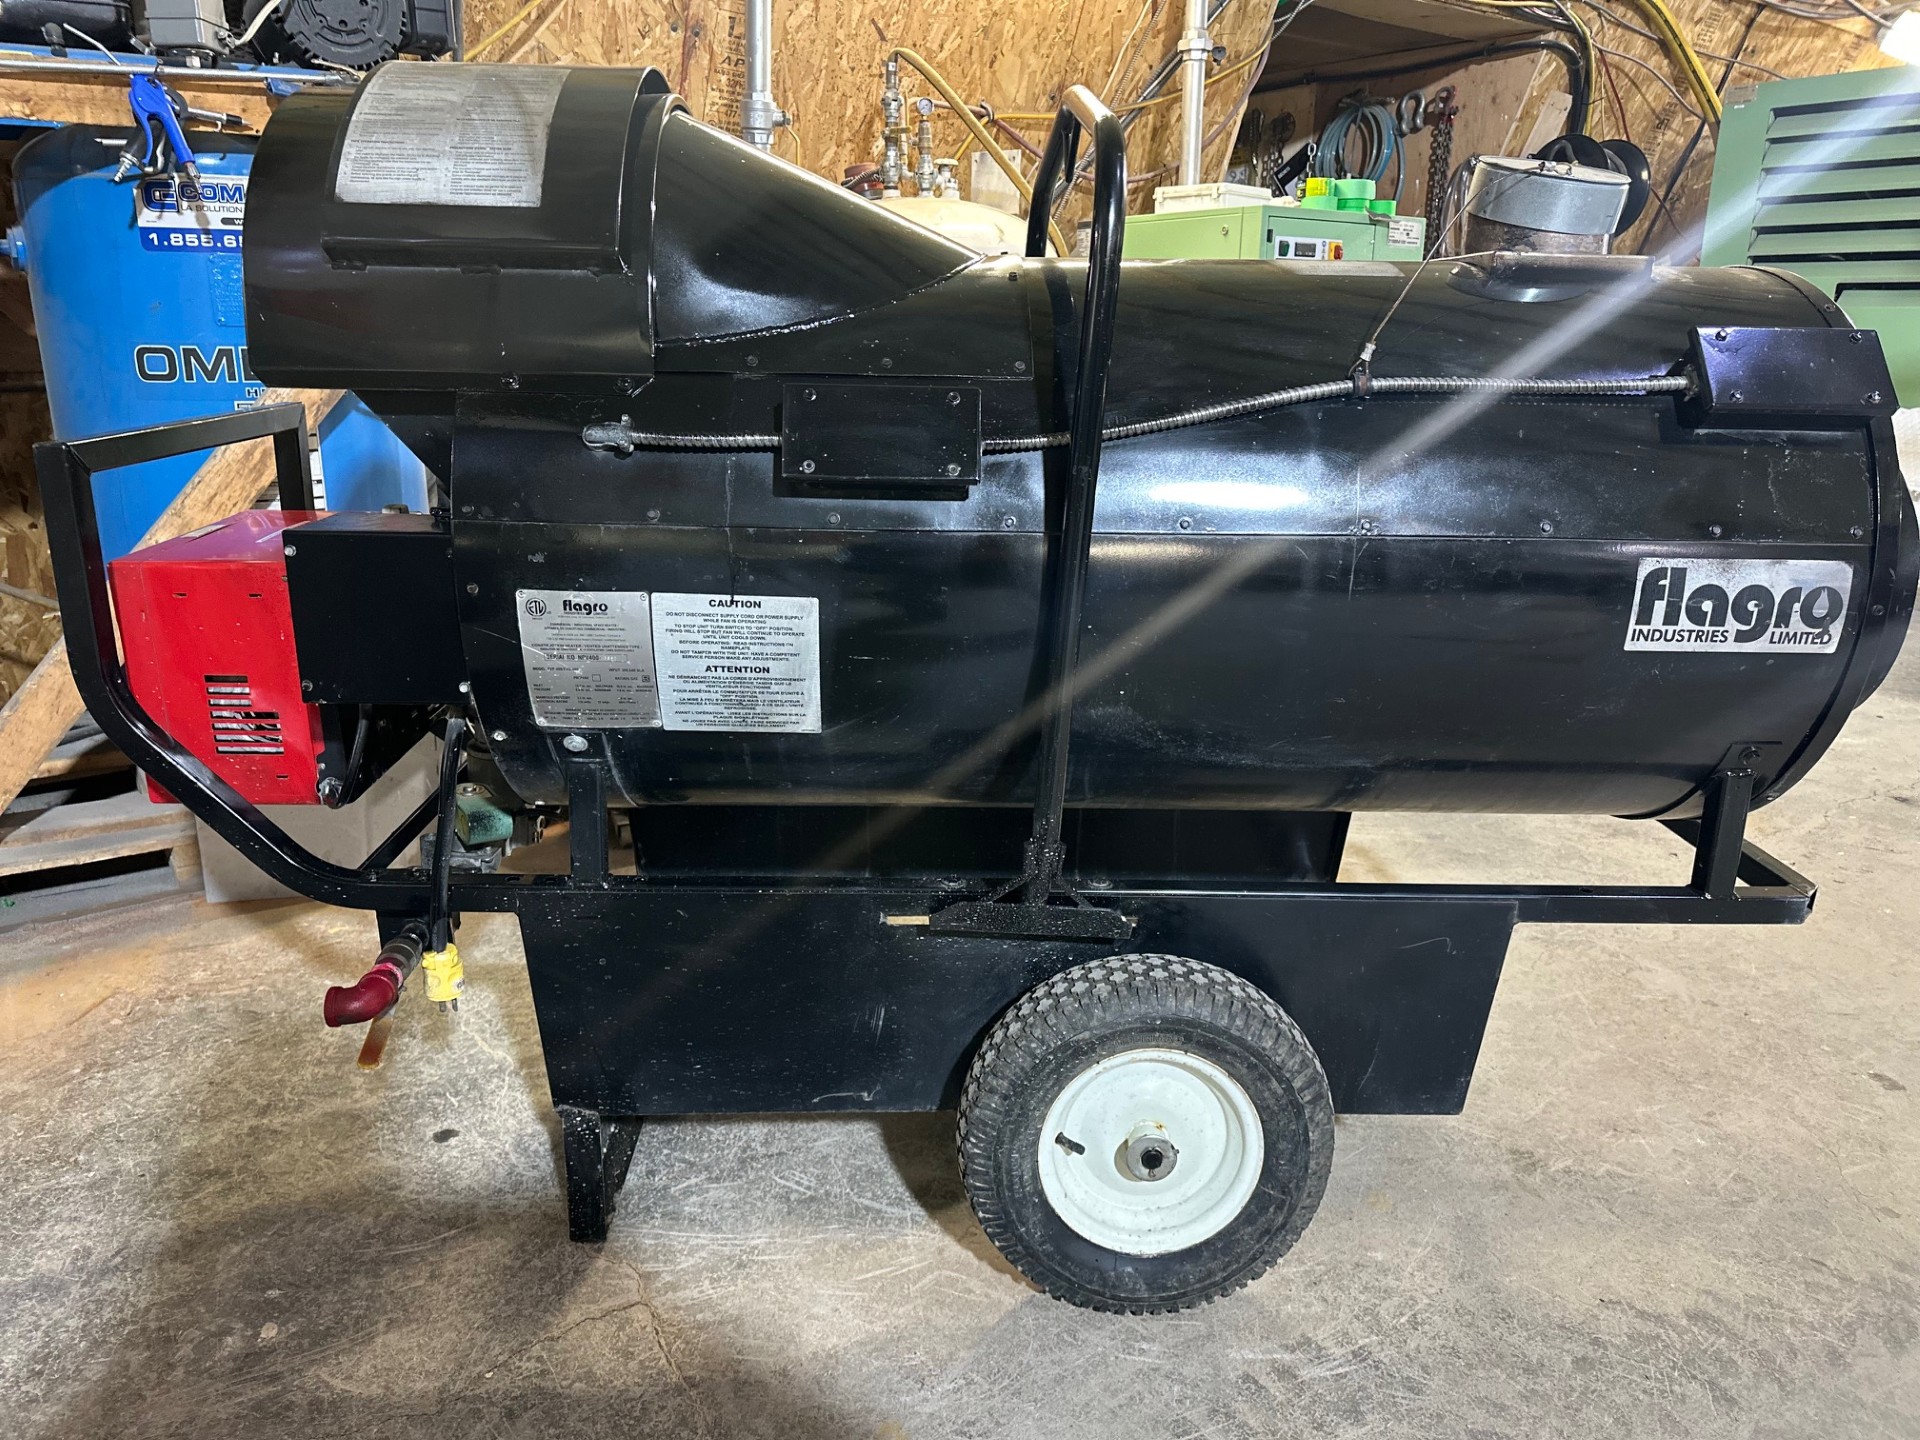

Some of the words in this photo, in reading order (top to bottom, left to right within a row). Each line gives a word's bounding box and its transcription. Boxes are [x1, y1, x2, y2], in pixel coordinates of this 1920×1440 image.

[180, 204, 193, 212] LA
[196, 204, 243, 213] SOLUTION
[562, 599, 609, 616] flagro
[708, 599, 762, 609] CAUTION
[1634, 566, 1844, 643] flagro
[1630, 628, 1729, 643] INDUSTRIES
[1768, 631, 1832, 646] LIMITED
[705, 664, 770, 674] ATTENTION
